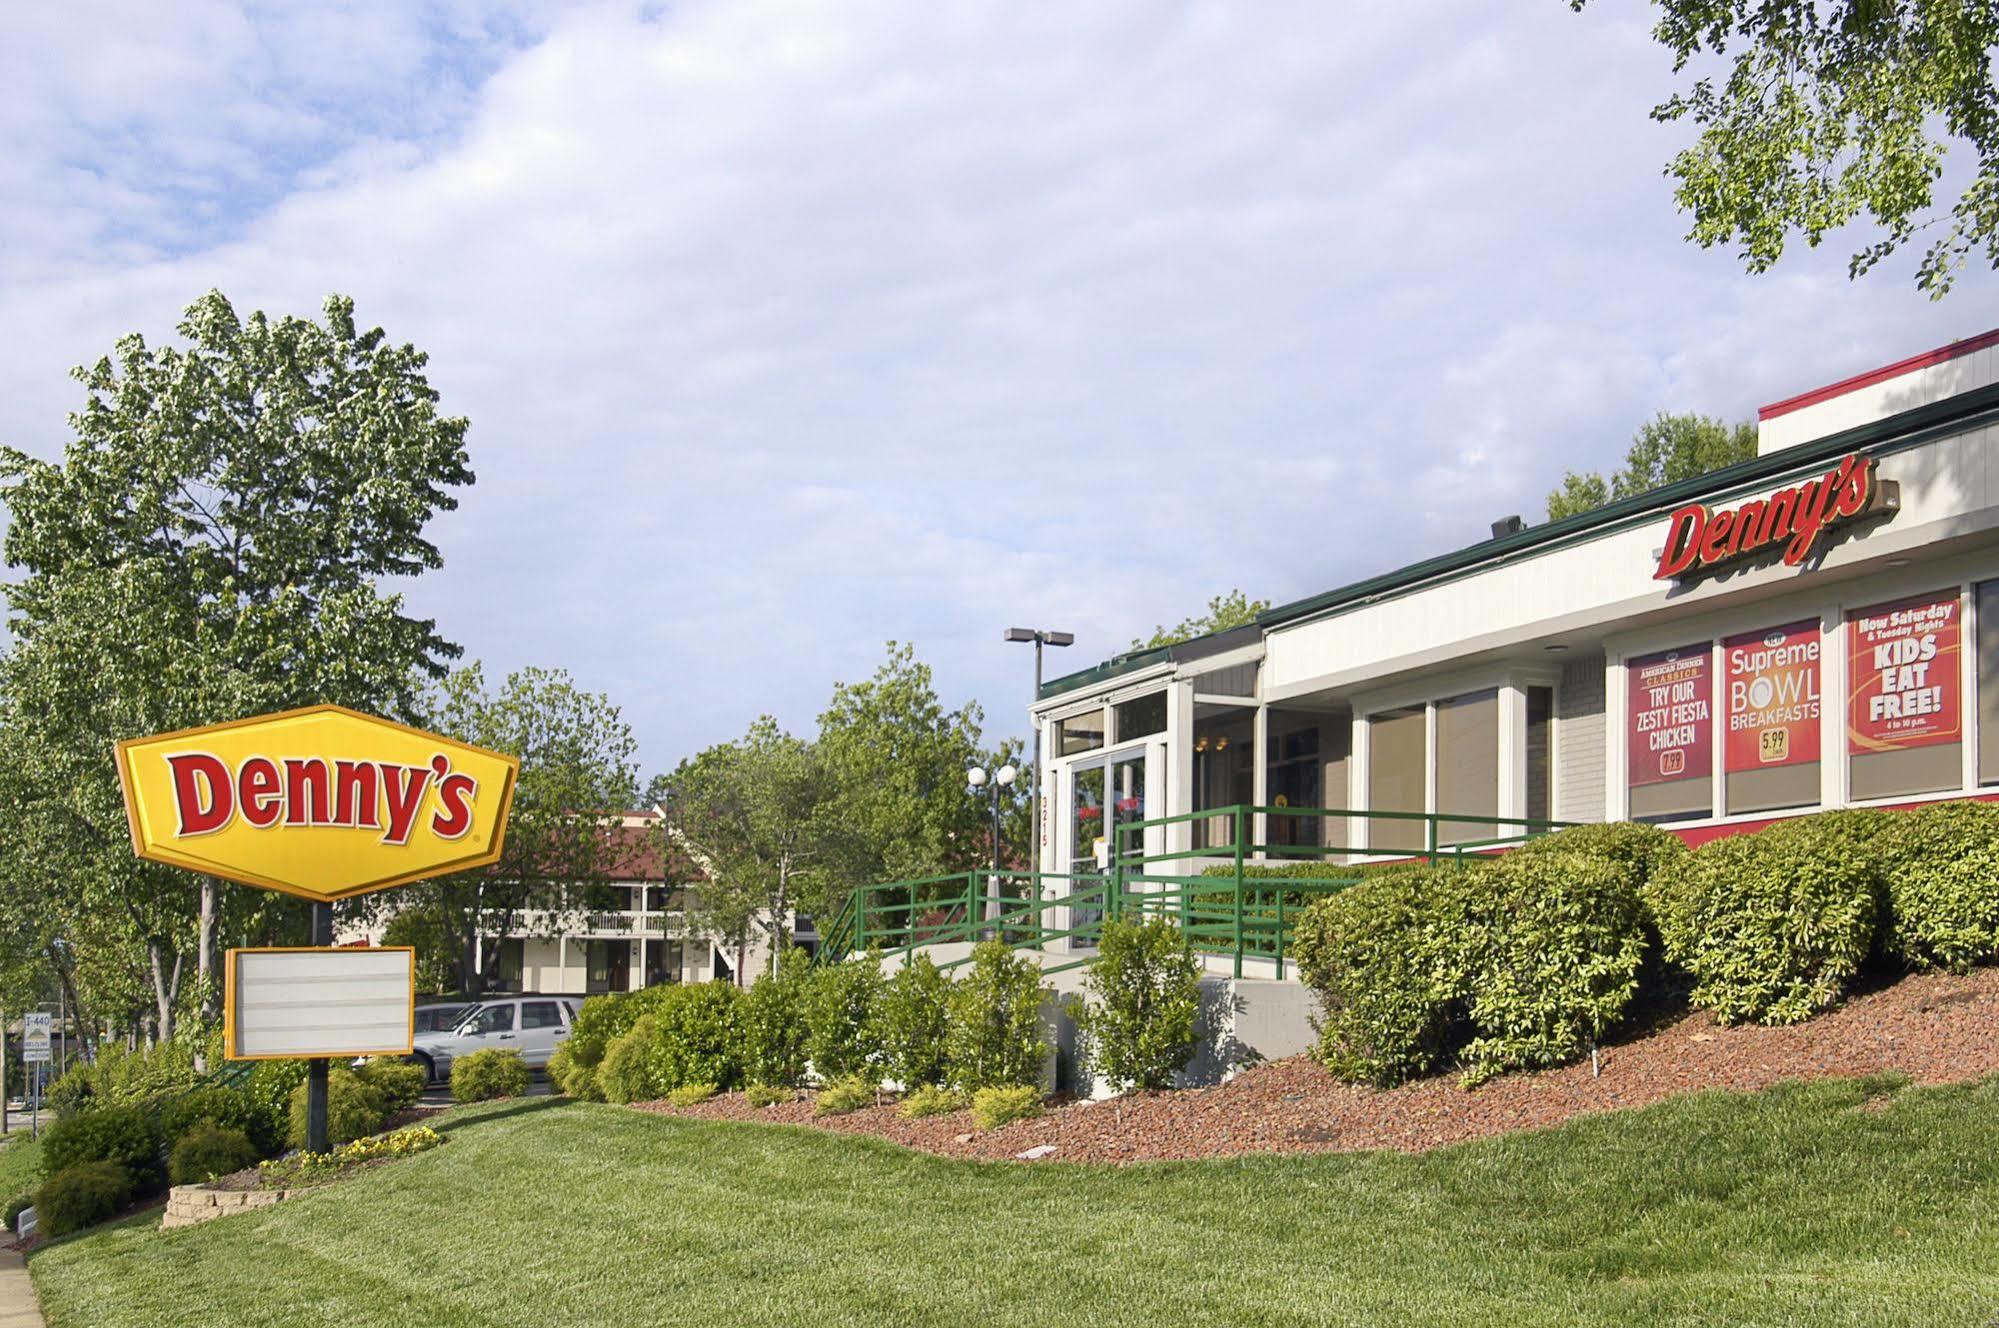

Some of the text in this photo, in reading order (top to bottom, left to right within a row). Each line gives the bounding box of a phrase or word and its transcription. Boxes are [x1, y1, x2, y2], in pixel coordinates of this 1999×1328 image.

[1653, 455, 1873, 580] Denny's
[1859, 604, 1953, 633] Now Saturday
[1876, 626, 1912, 639] Tuesday
[1915, 620, 1944, 633] Nights
[1731, 641, 1819, 677] Supreme
[1874, 634, 1937, 670] KIDS
[1640, 664, 1676, 679] AMERICAN
[1647, 667, 1697, 686] CLASSICS
[1882, 662, 1929, 694] EAT
[1649, 681, 1695, 708] TRY OUR
[1731, 668, 1819, 714] BOWL
[1870, 685, 1942, 722] FREE!
[1637, 701, 1709, 732] ZESTY FIESTA
[1731, 702, 1819, 731] BREAKFASTS
[1893, 721, 1901, 729] to
[1903, 719, 1910, 727] 10
[1650, 724, 1696, 751] CHICKEN
[1763, 731, 1784, 750] 5.99
[1663, 752, 1681, 769] 7.99
[162, 752, 479, 845] Denny's
[26, 1016, 50, 1026] I-440
